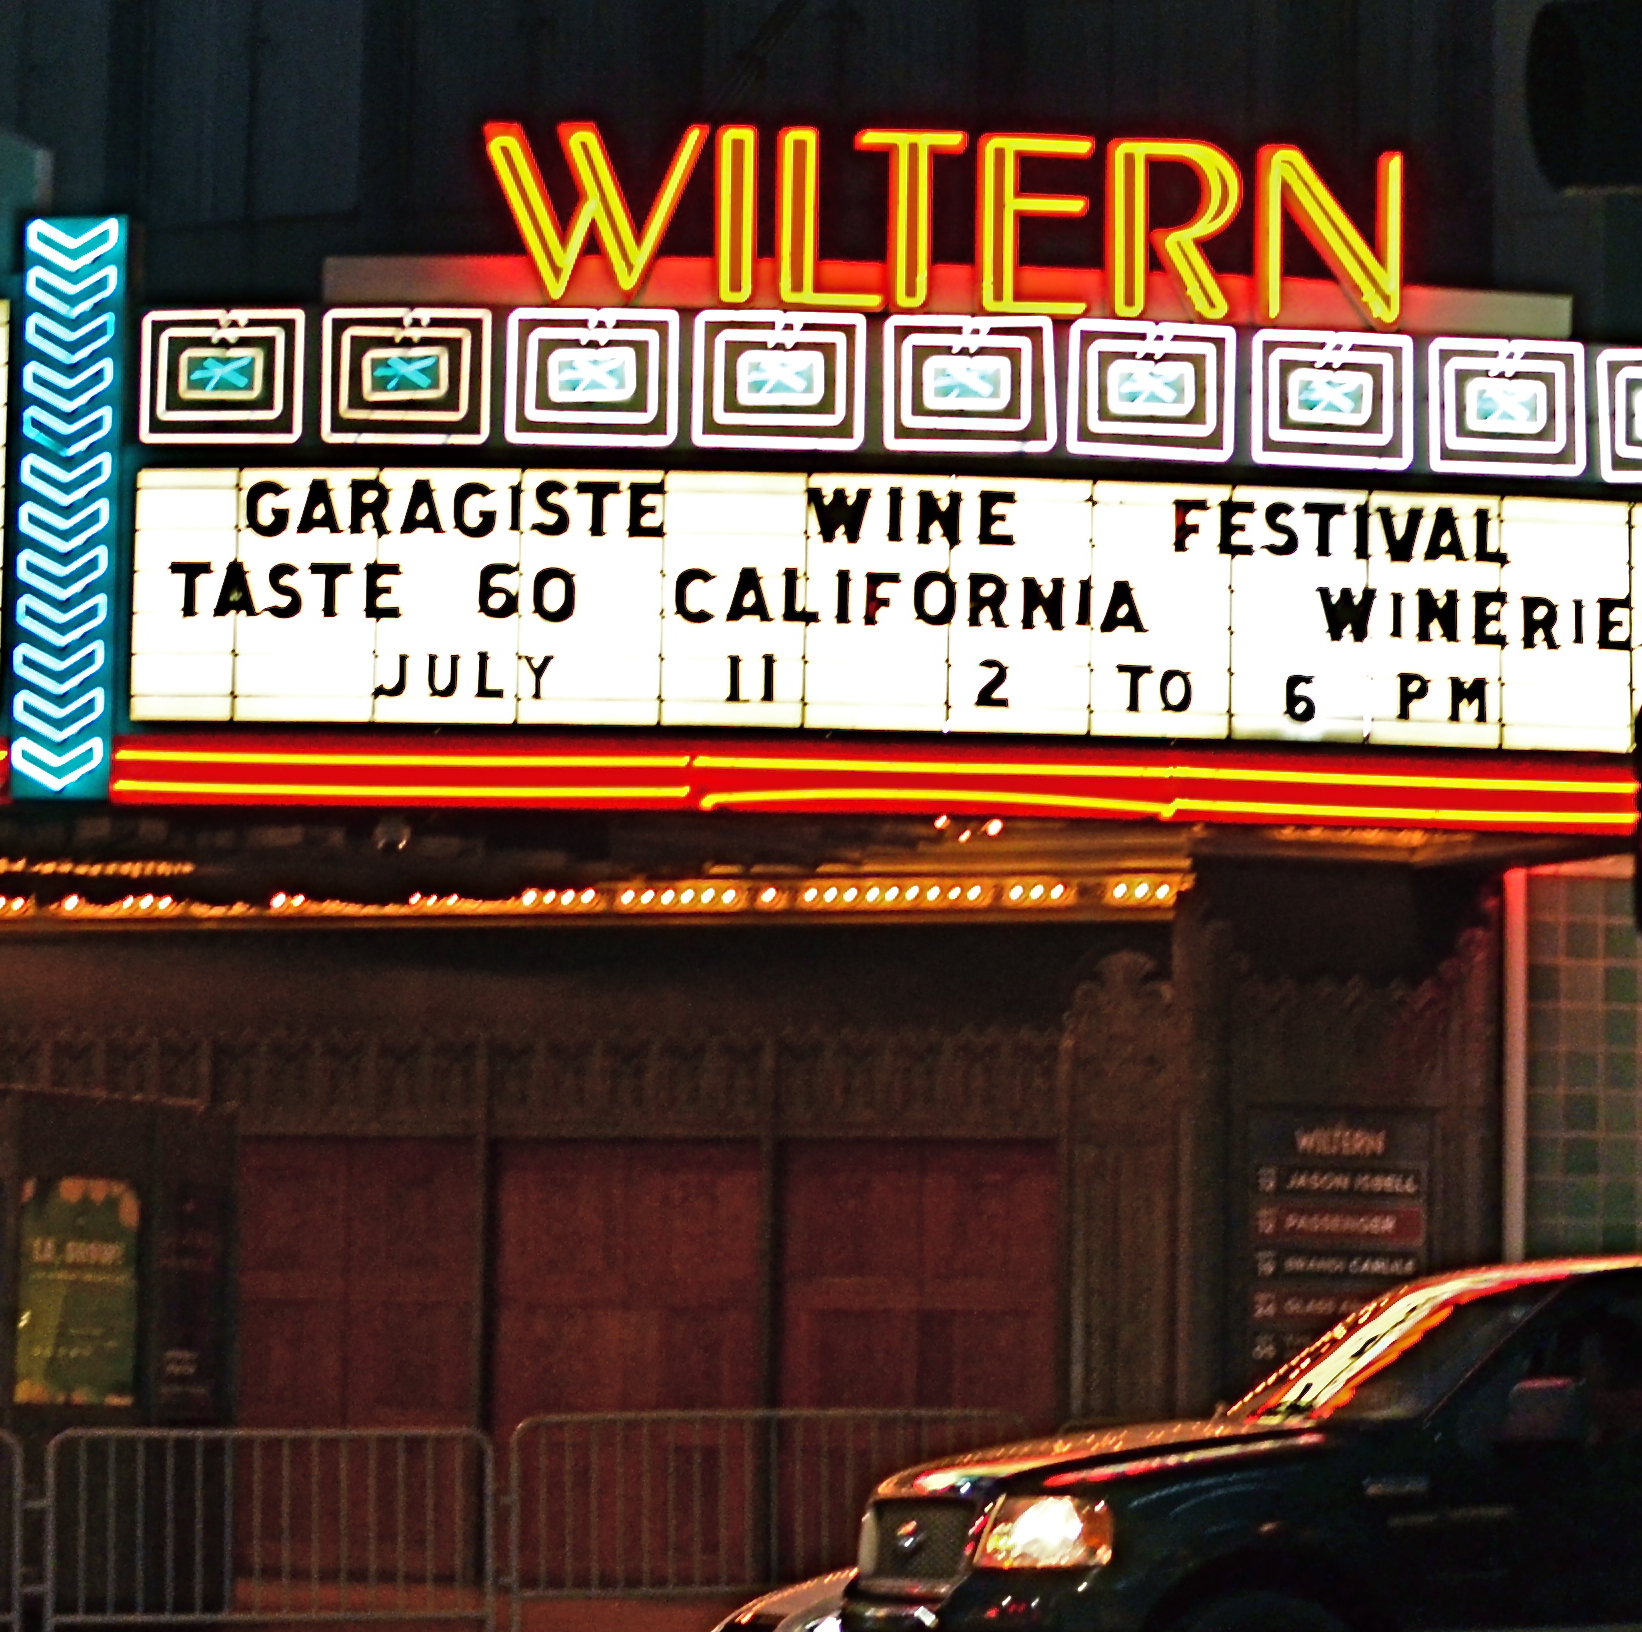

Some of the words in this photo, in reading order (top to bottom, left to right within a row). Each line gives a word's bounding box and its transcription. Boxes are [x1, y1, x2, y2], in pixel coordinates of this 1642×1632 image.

[483, 121, 1404, 327] WILTERN
[244, 480, 667, 539] GARAGISTE
[807, 486, 1017, 547] WINE
[1172, 498, 1509, 567] FESTIVAL
[168, 561, 403, 619] TASTE
[476, 567, 577, 622] 60
[673, 567, 1149, 635] CALIFORNIA
[372, 652, 556, 701] JULY
[975, 659, 1010, 708] 2
[1116, 664, 1194, 715] TO
[1283, 673, 1317, 723] 6
